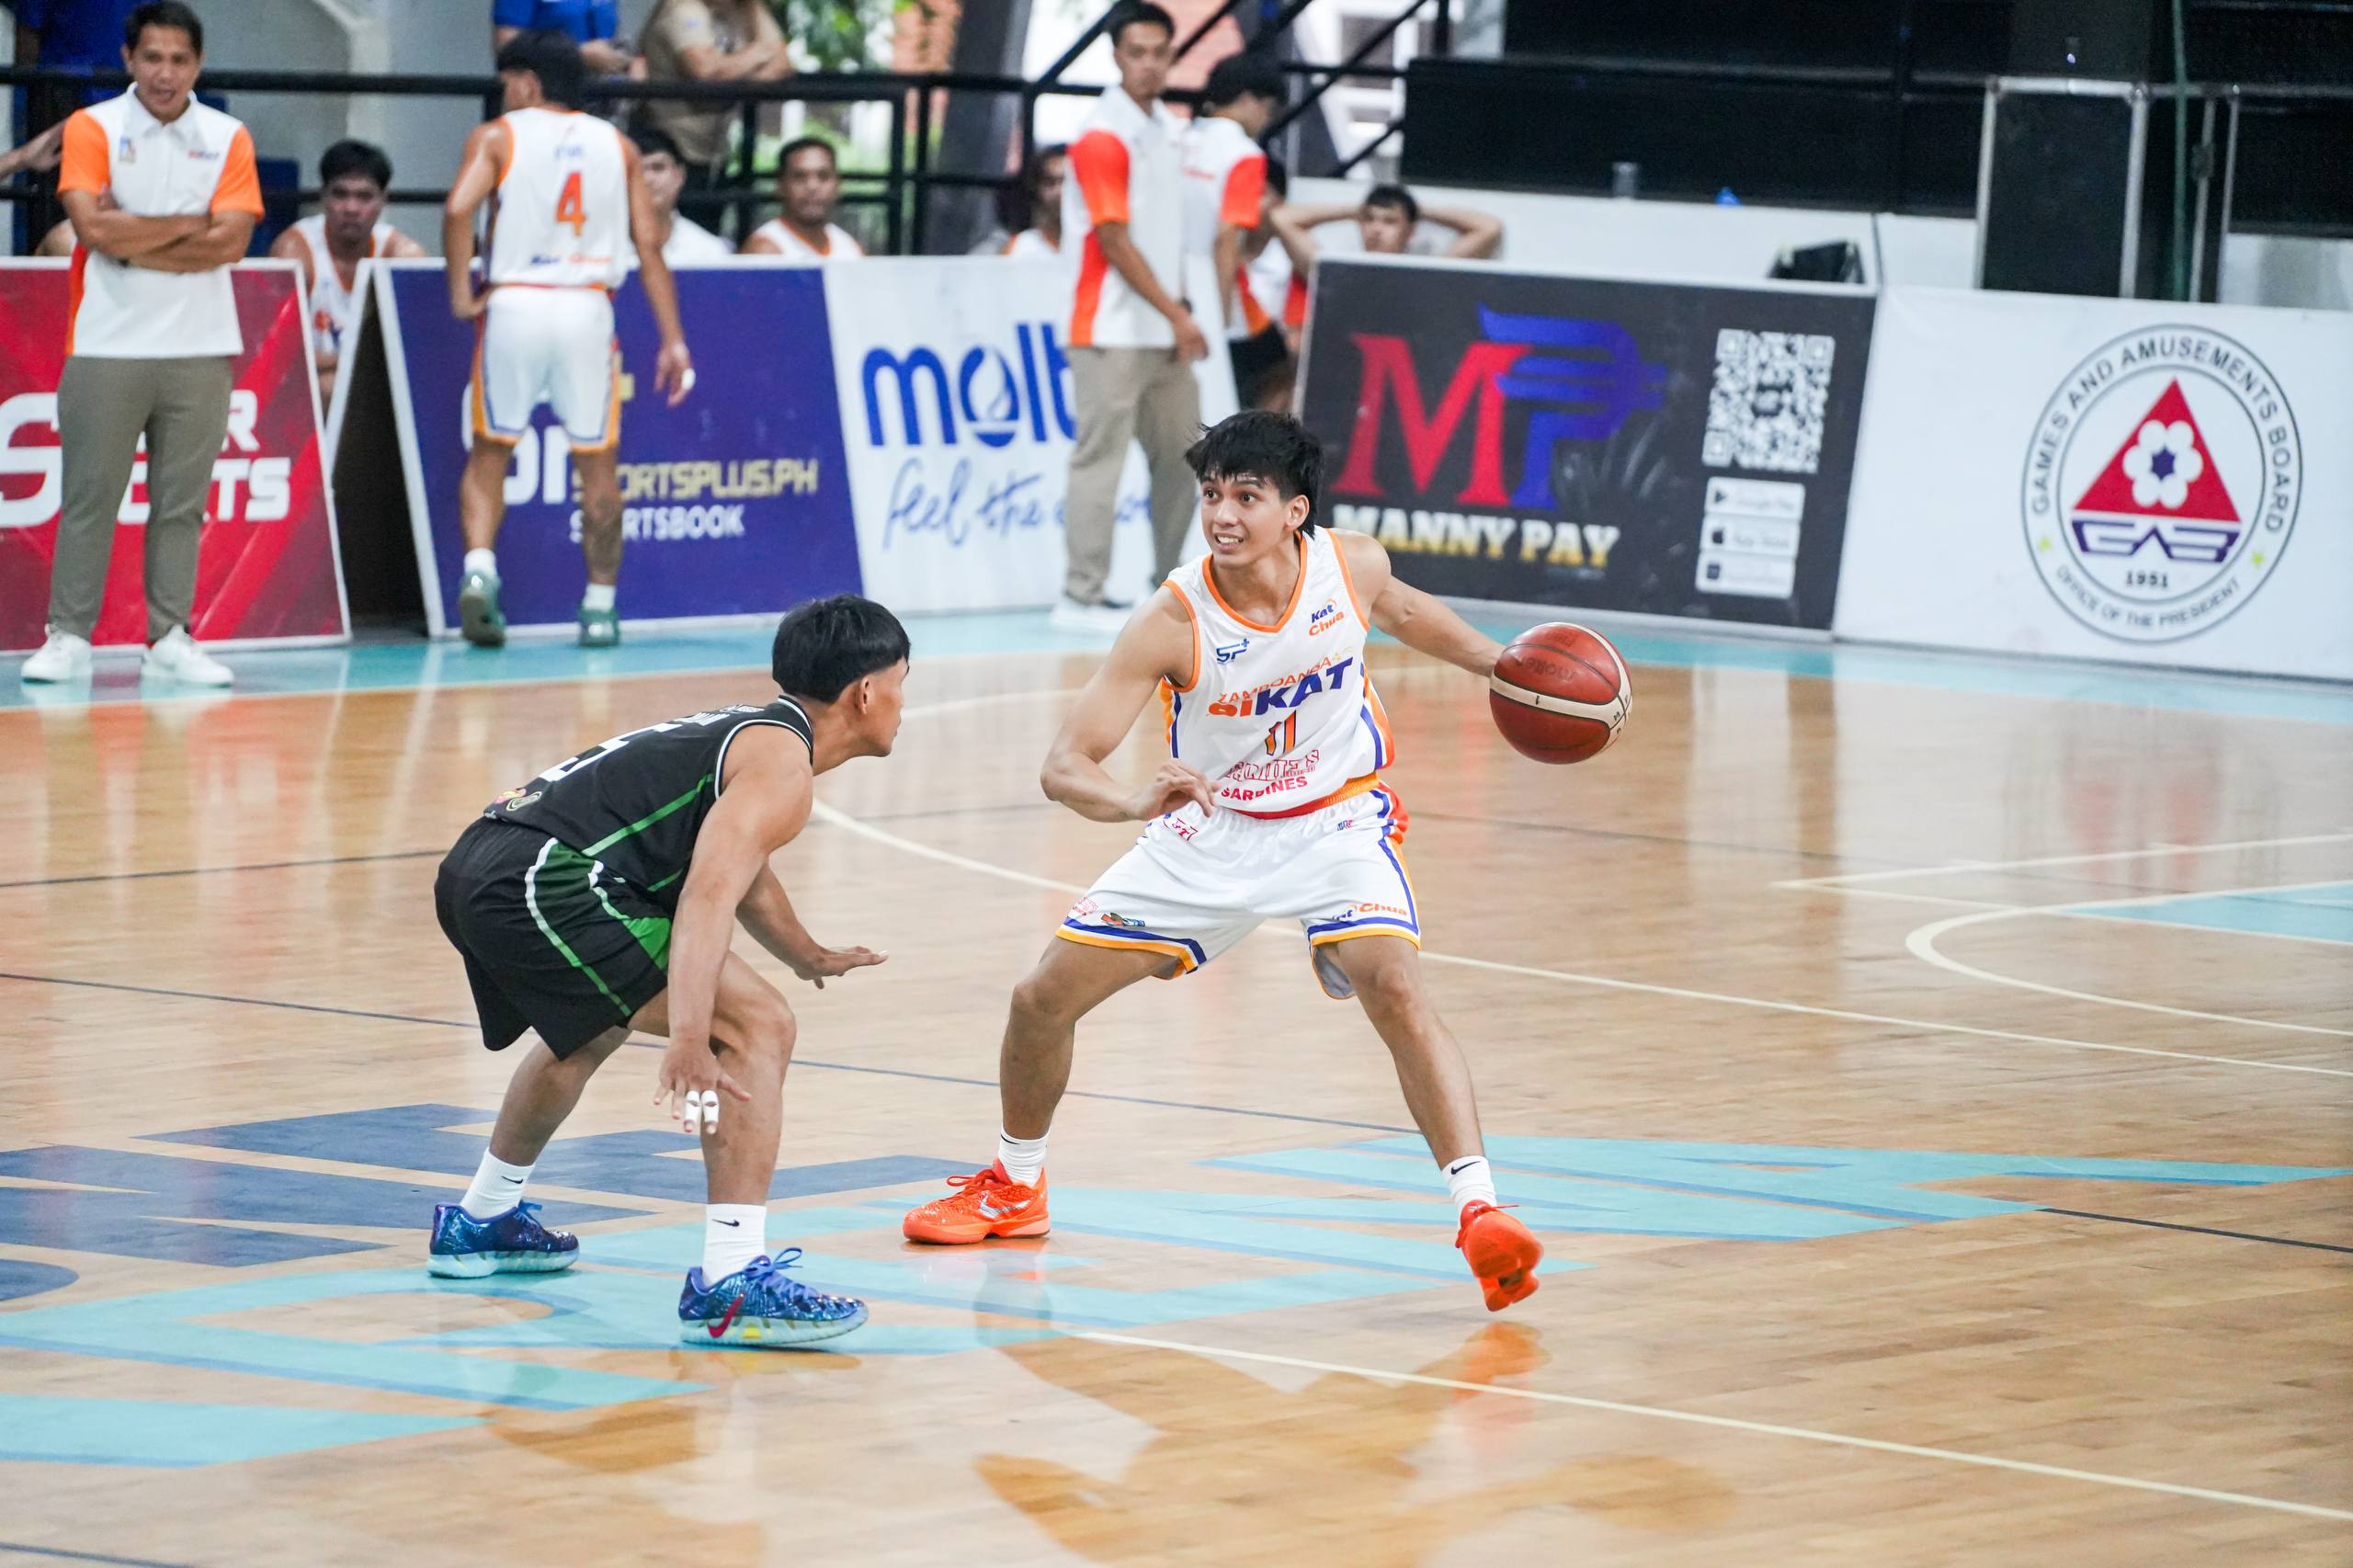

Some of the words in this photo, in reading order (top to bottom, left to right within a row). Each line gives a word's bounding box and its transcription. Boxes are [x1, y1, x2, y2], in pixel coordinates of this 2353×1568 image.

[554, 171, 587, 237] 4
[862, 322, 1079, 448] molt
[2031, 410, 2070, 516] GAMES
[2068, 358, 2115, 411] AND
[2120, 335, 2279, 420] AMUSEMENTS
[2265, 425, 2291, 532] BOARD
[571, 459, 820, 503] ORTSPLUS.PH
[882, 458, 972, 551] feel
[568, 504, 746, 543] SRTSBOOK
[1333, 504, 1518, 560] MANNY
[1519, 518, 1620, 569] PAY
[1308, 611, 1346, 637] Chua
[1311, 603, 1336, 624] Kat
[2101, 603, 2120, 619] OF
[2126, 610, 2153, 627] THE
[2159, 577, 2241, 626] PRESIDENT
[1264, 709, 1297, 756] 11
[1358, 902, 1408, 917] Chua
